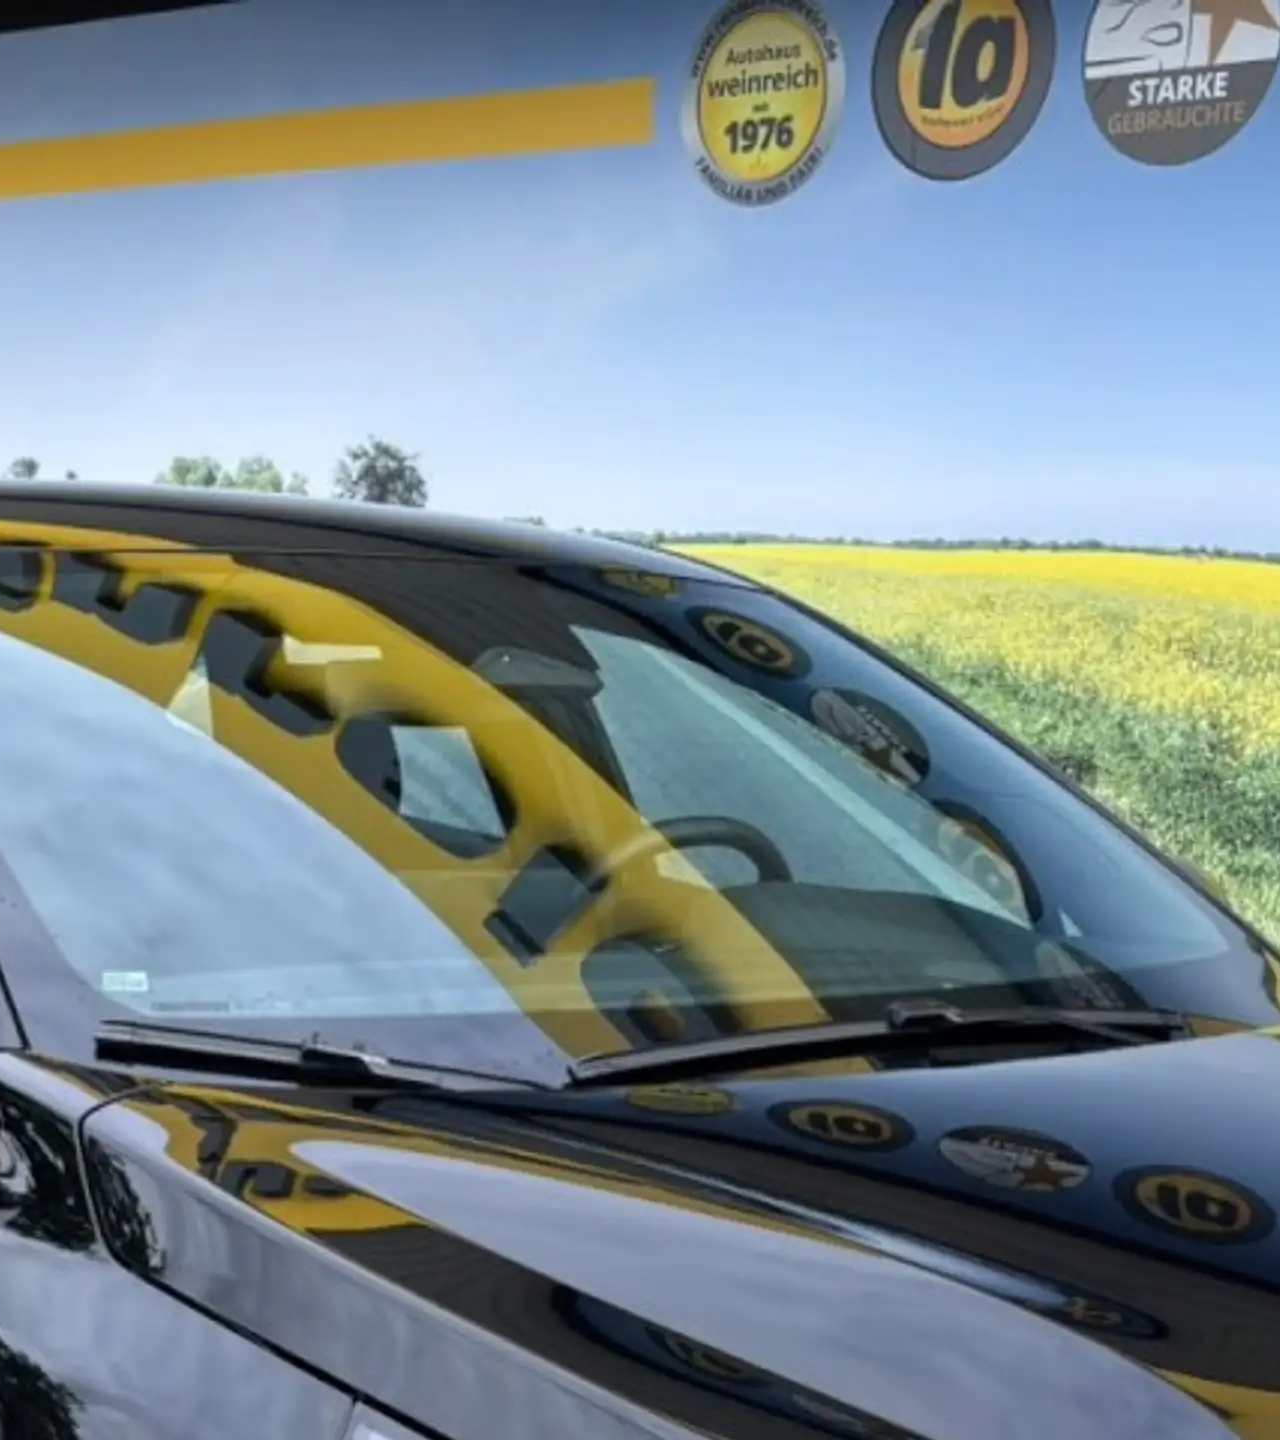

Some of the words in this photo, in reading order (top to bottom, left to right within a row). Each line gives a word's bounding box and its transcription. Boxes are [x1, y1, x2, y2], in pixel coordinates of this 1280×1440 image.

[724, 44, 803, 66] Autohaus
[1127, 71, 1230, 107] STARKE
[724, 114, 795, 155] 1976
[1107, 99, 1248, 136] GEBRAUCHTE
